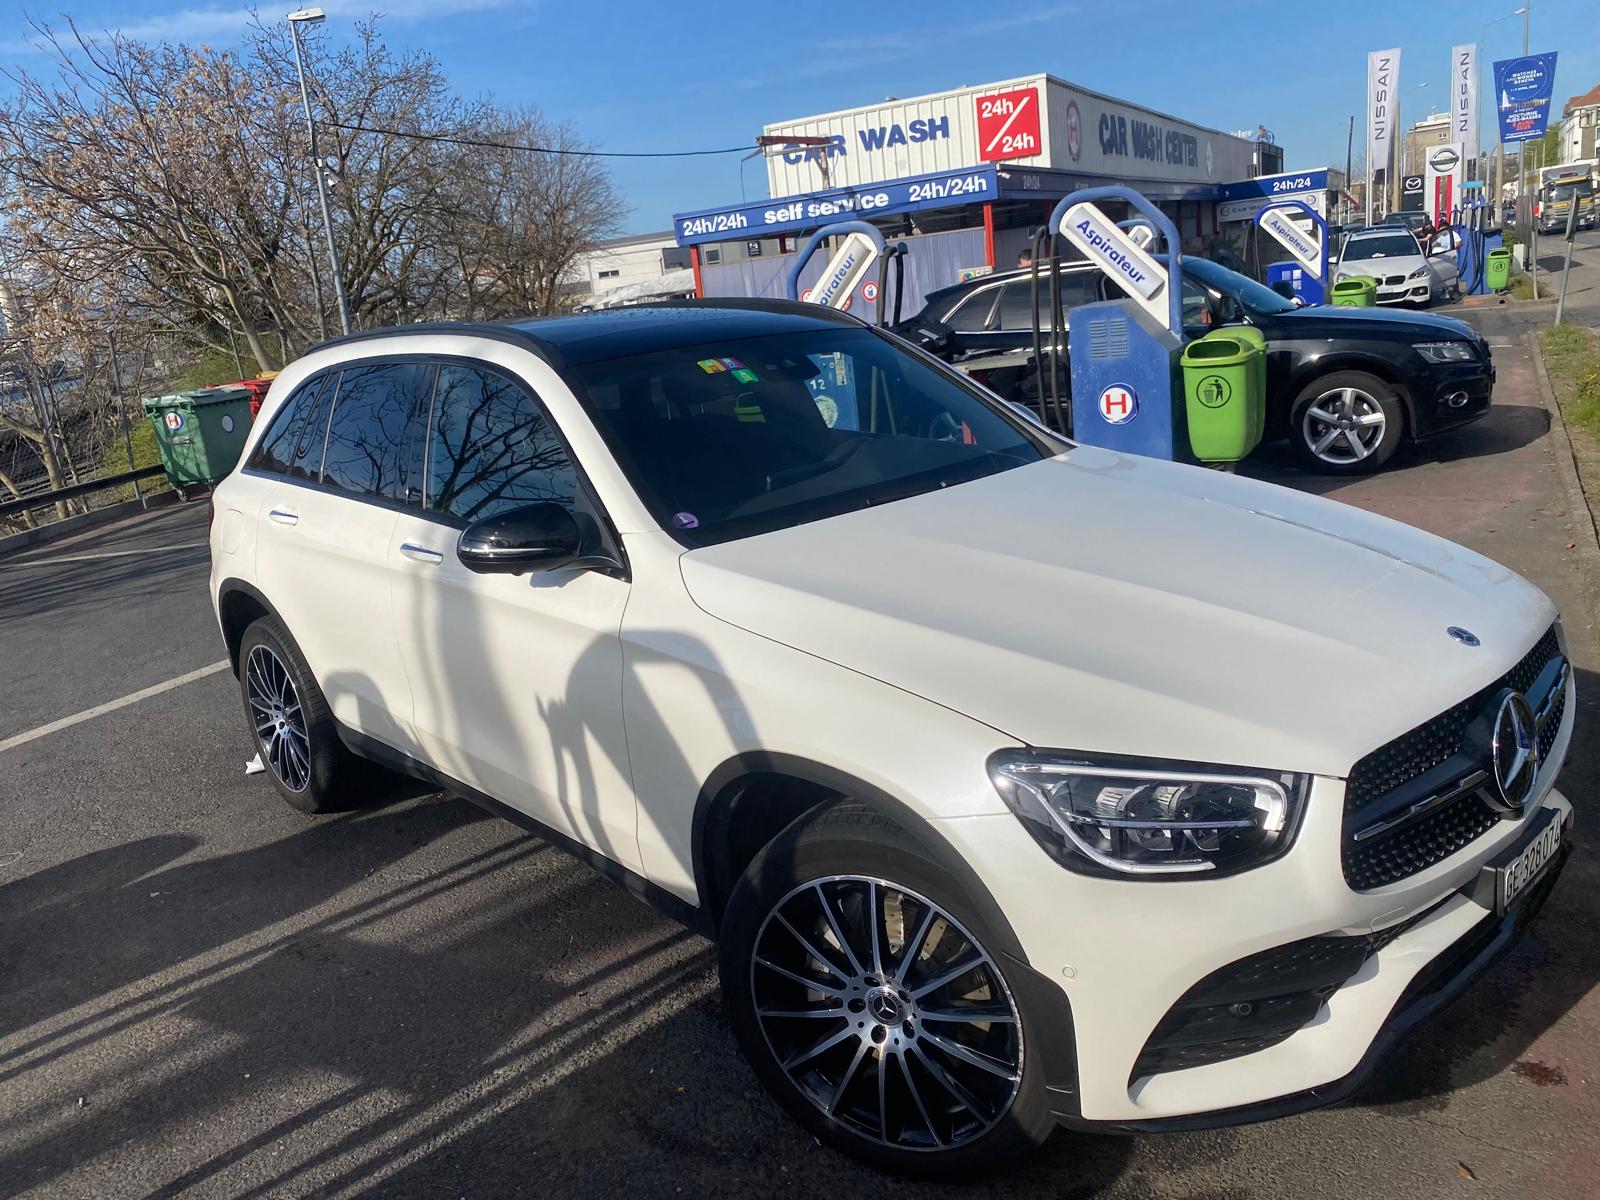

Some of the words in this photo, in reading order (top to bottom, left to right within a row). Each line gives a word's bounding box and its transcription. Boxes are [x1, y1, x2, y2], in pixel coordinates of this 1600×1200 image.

[981, 98, 1014, 118] 24h
[1375, 58, 1390, 140] NISSAN
[1460, 52, 1470, 132] NISSAN
[858, 116, 950, 152] WASH
[1002, 132, 1034, 153] 24h
[1099, 113, 1128, 156] CAR
[1131, 120, 1163, 162] WASH
[1273, 177, 1311, 192] 24h/24
[683, 213, 747, 236] 24h/24h
[764, 203, 802, 224] self
[807, 192, 889, 217] service
[909, 176, 987, 202] 24h/24h
[1076, 219, 1146, 284] Aspirateur
[1271, 220, 1309, 255] Aspirateur
[819, 253, 855, 306] pirateur
[1105, 393, 1127, 415] H
